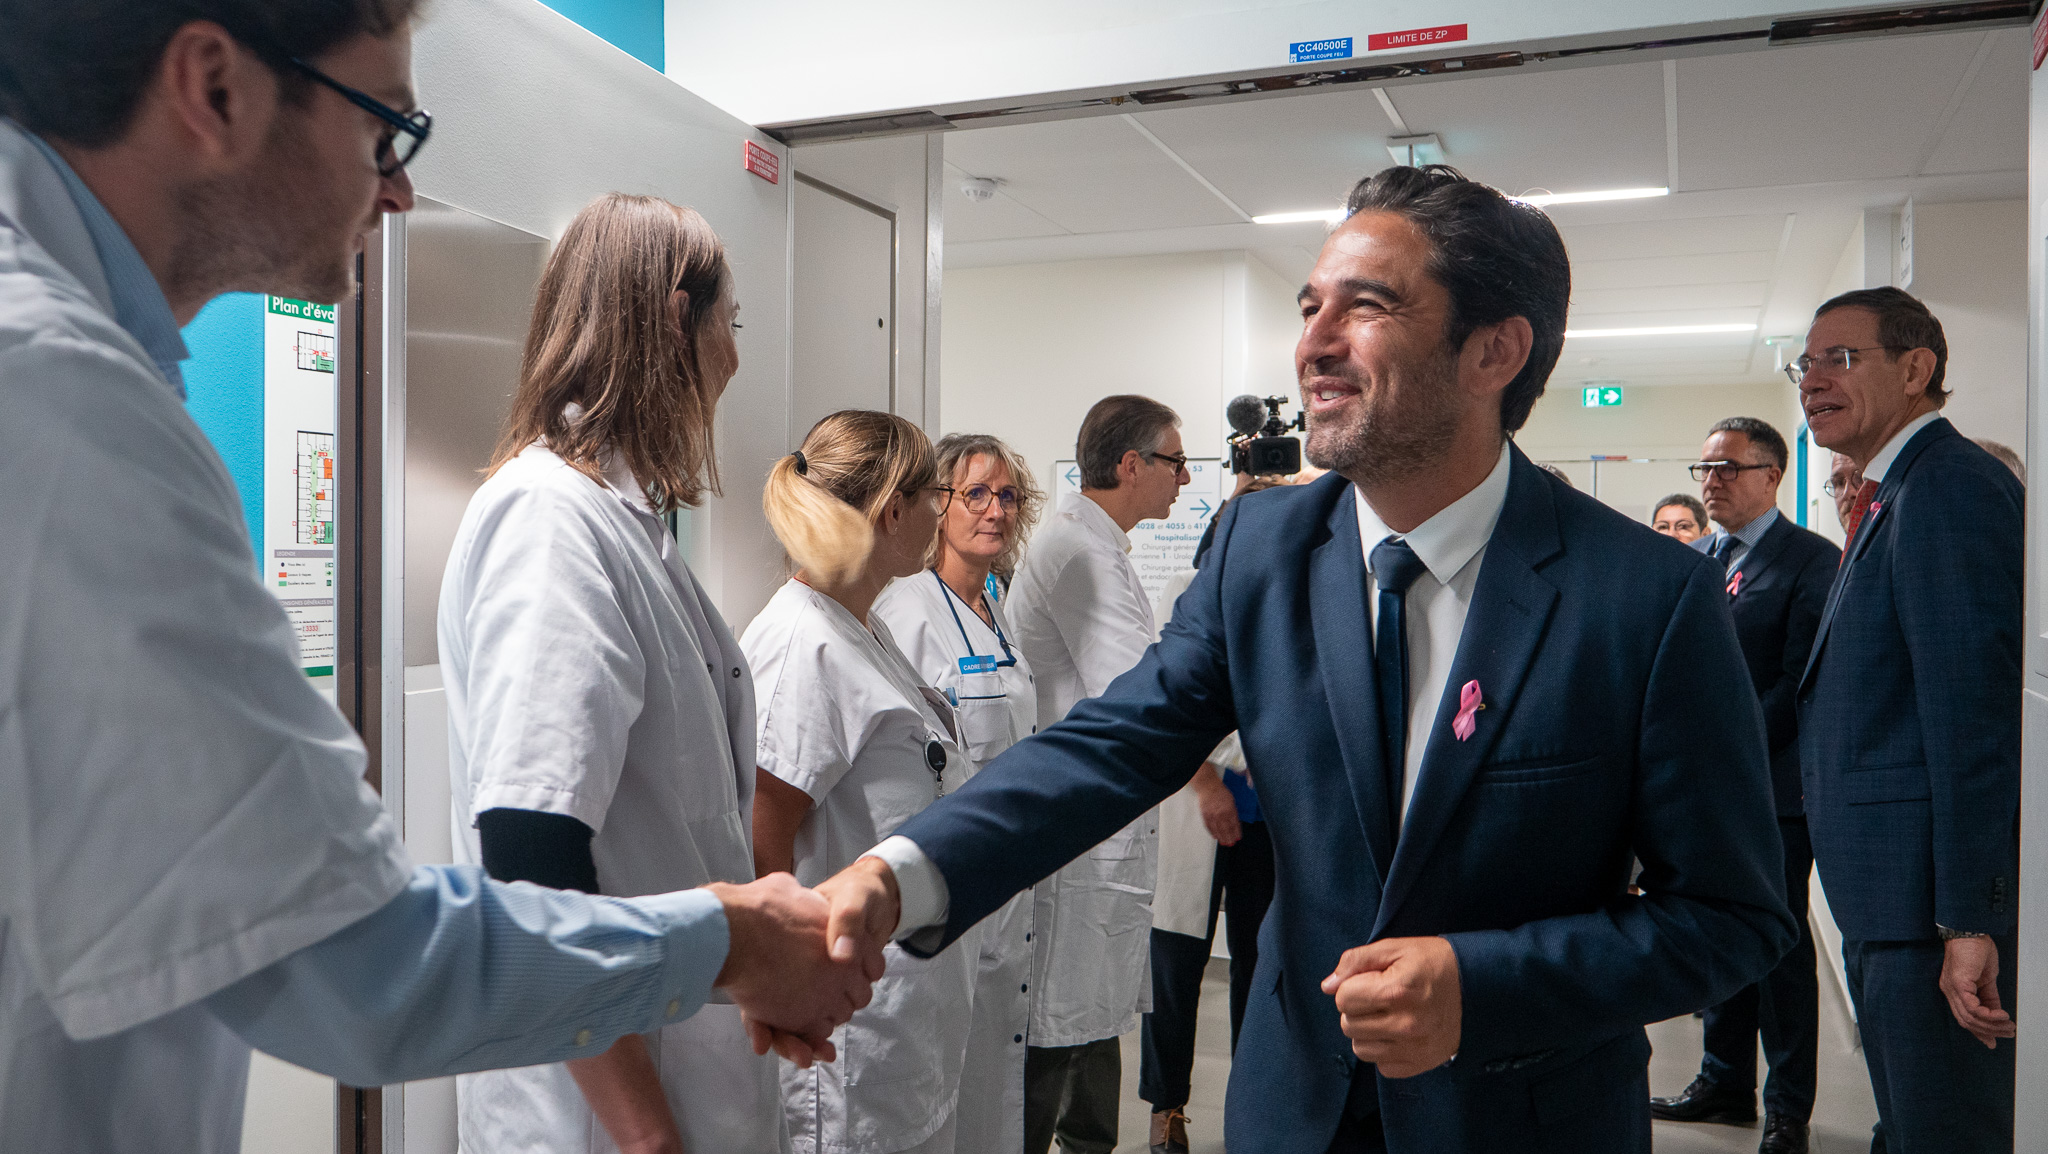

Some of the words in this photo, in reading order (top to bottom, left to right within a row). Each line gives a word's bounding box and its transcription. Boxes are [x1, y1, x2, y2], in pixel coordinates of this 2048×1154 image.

[1387, 33, 1417, 45] LIMITE
[1420, 31, 1433, 41] DE
[1434, 30, 1448, 40] ZP
[1297, 39, 1348, 53] CC40500E
[273, 296, 299, 314] Plan
[1192, 464, 1203, 472] 53
[1142, 544, 1172, 552] Chirurgie
[1142, 564, 1172, 572] Chirurgie
